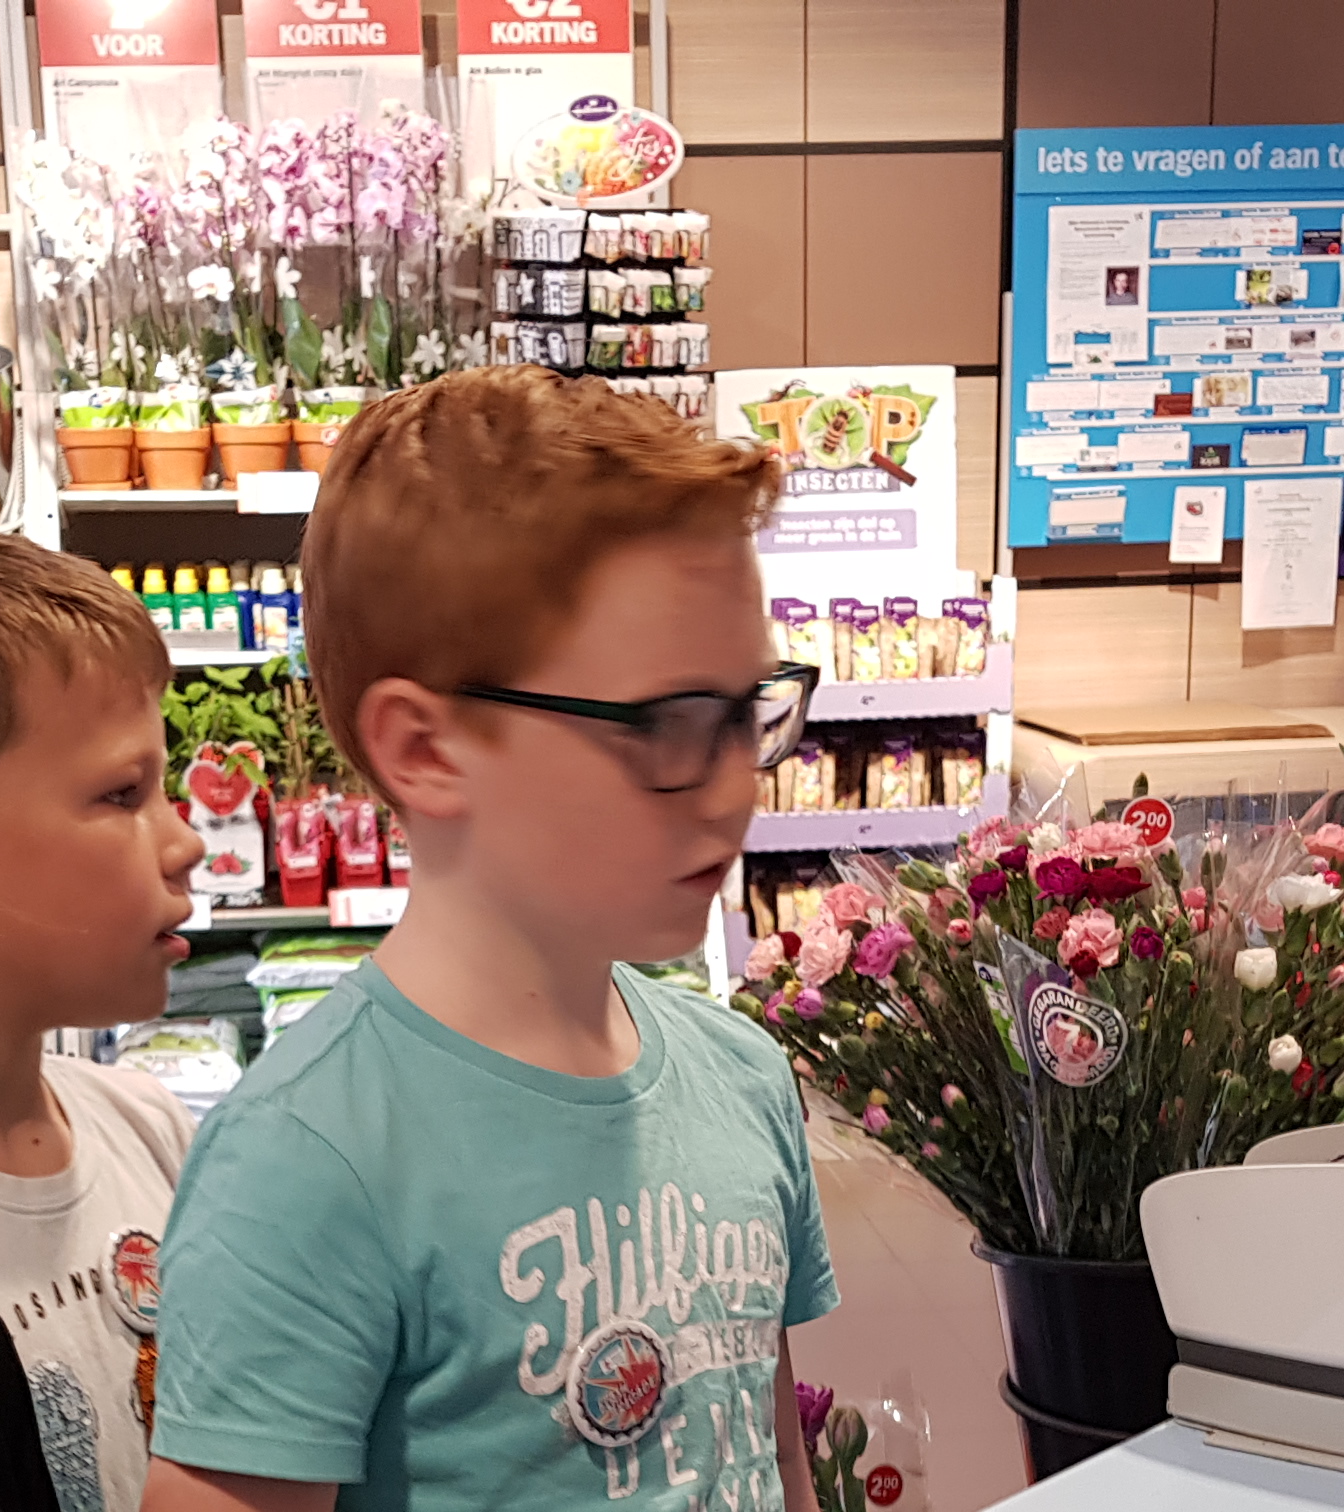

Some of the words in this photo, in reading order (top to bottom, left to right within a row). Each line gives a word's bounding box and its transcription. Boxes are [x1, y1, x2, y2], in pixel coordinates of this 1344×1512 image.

[279, 22, 387, 46] KORTING
[491, 21, 598, 44] KORTING
[92, 33, 164, 57] VOOR
[1038, 146, 1087, 172] Iets
[1096, 147, 1124, 172] te
[1133, 148, 1225, 178] vragen
[1234, 142, 1263, 170] of
[1269, 148, 1319, 170] aan
[785, 471, 890, 493] INSECTEN
